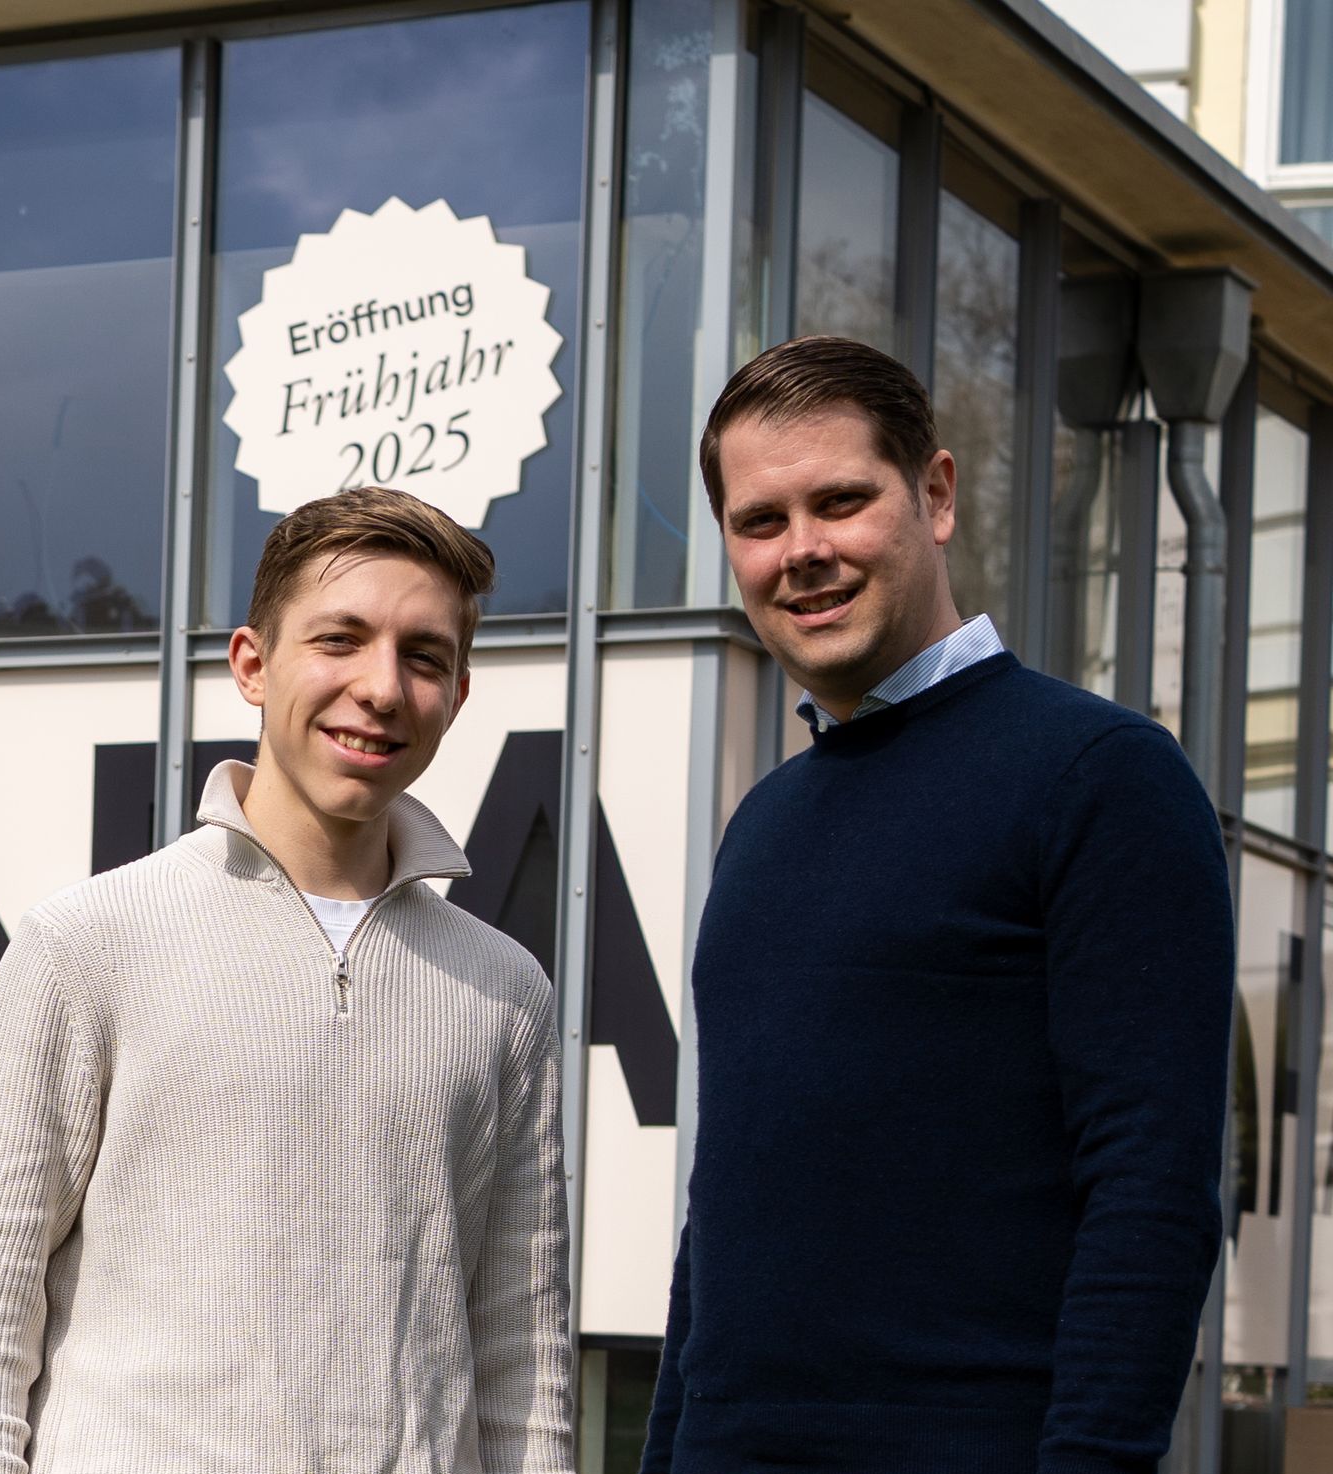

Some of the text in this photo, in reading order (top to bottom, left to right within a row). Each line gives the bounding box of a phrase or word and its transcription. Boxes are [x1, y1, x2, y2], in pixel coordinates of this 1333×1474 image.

[288, 283, 474, 355] Eröffnung
[275, 328, 515, 437] Frühjahr
[336, 409, 471, 495] 2025
